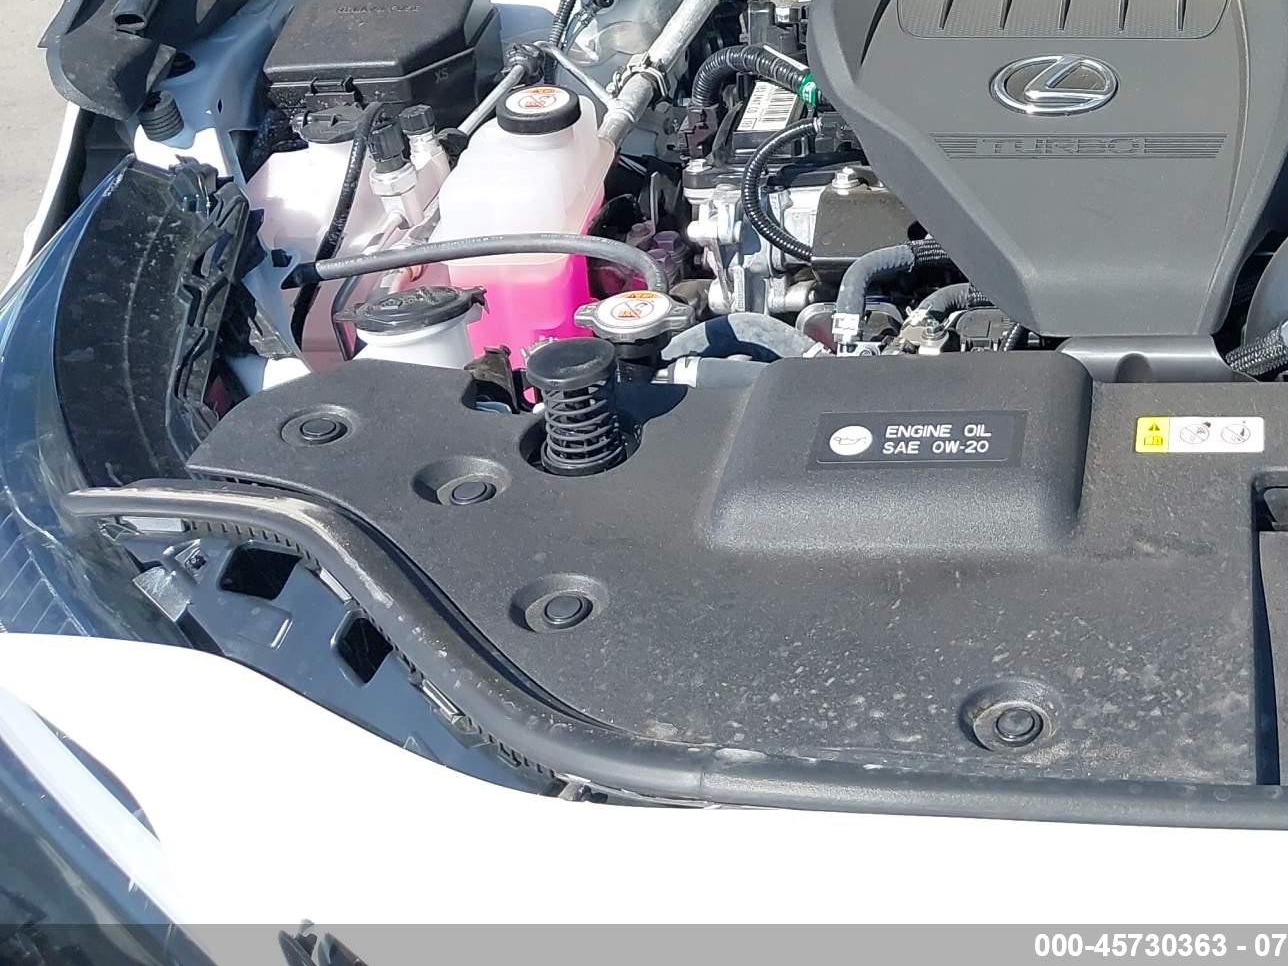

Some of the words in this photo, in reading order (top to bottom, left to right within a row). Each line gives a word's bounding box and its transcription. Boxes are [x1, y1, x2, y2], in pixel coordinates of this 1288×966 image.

[982, 137, 1138, 154] TURBO
[885, 424, 953, 439] ENGINE
[963, 423, 992, 438] OIL
[882, 440, 921, 455] SAE
[931, 439, 990, 454] 0W-20
